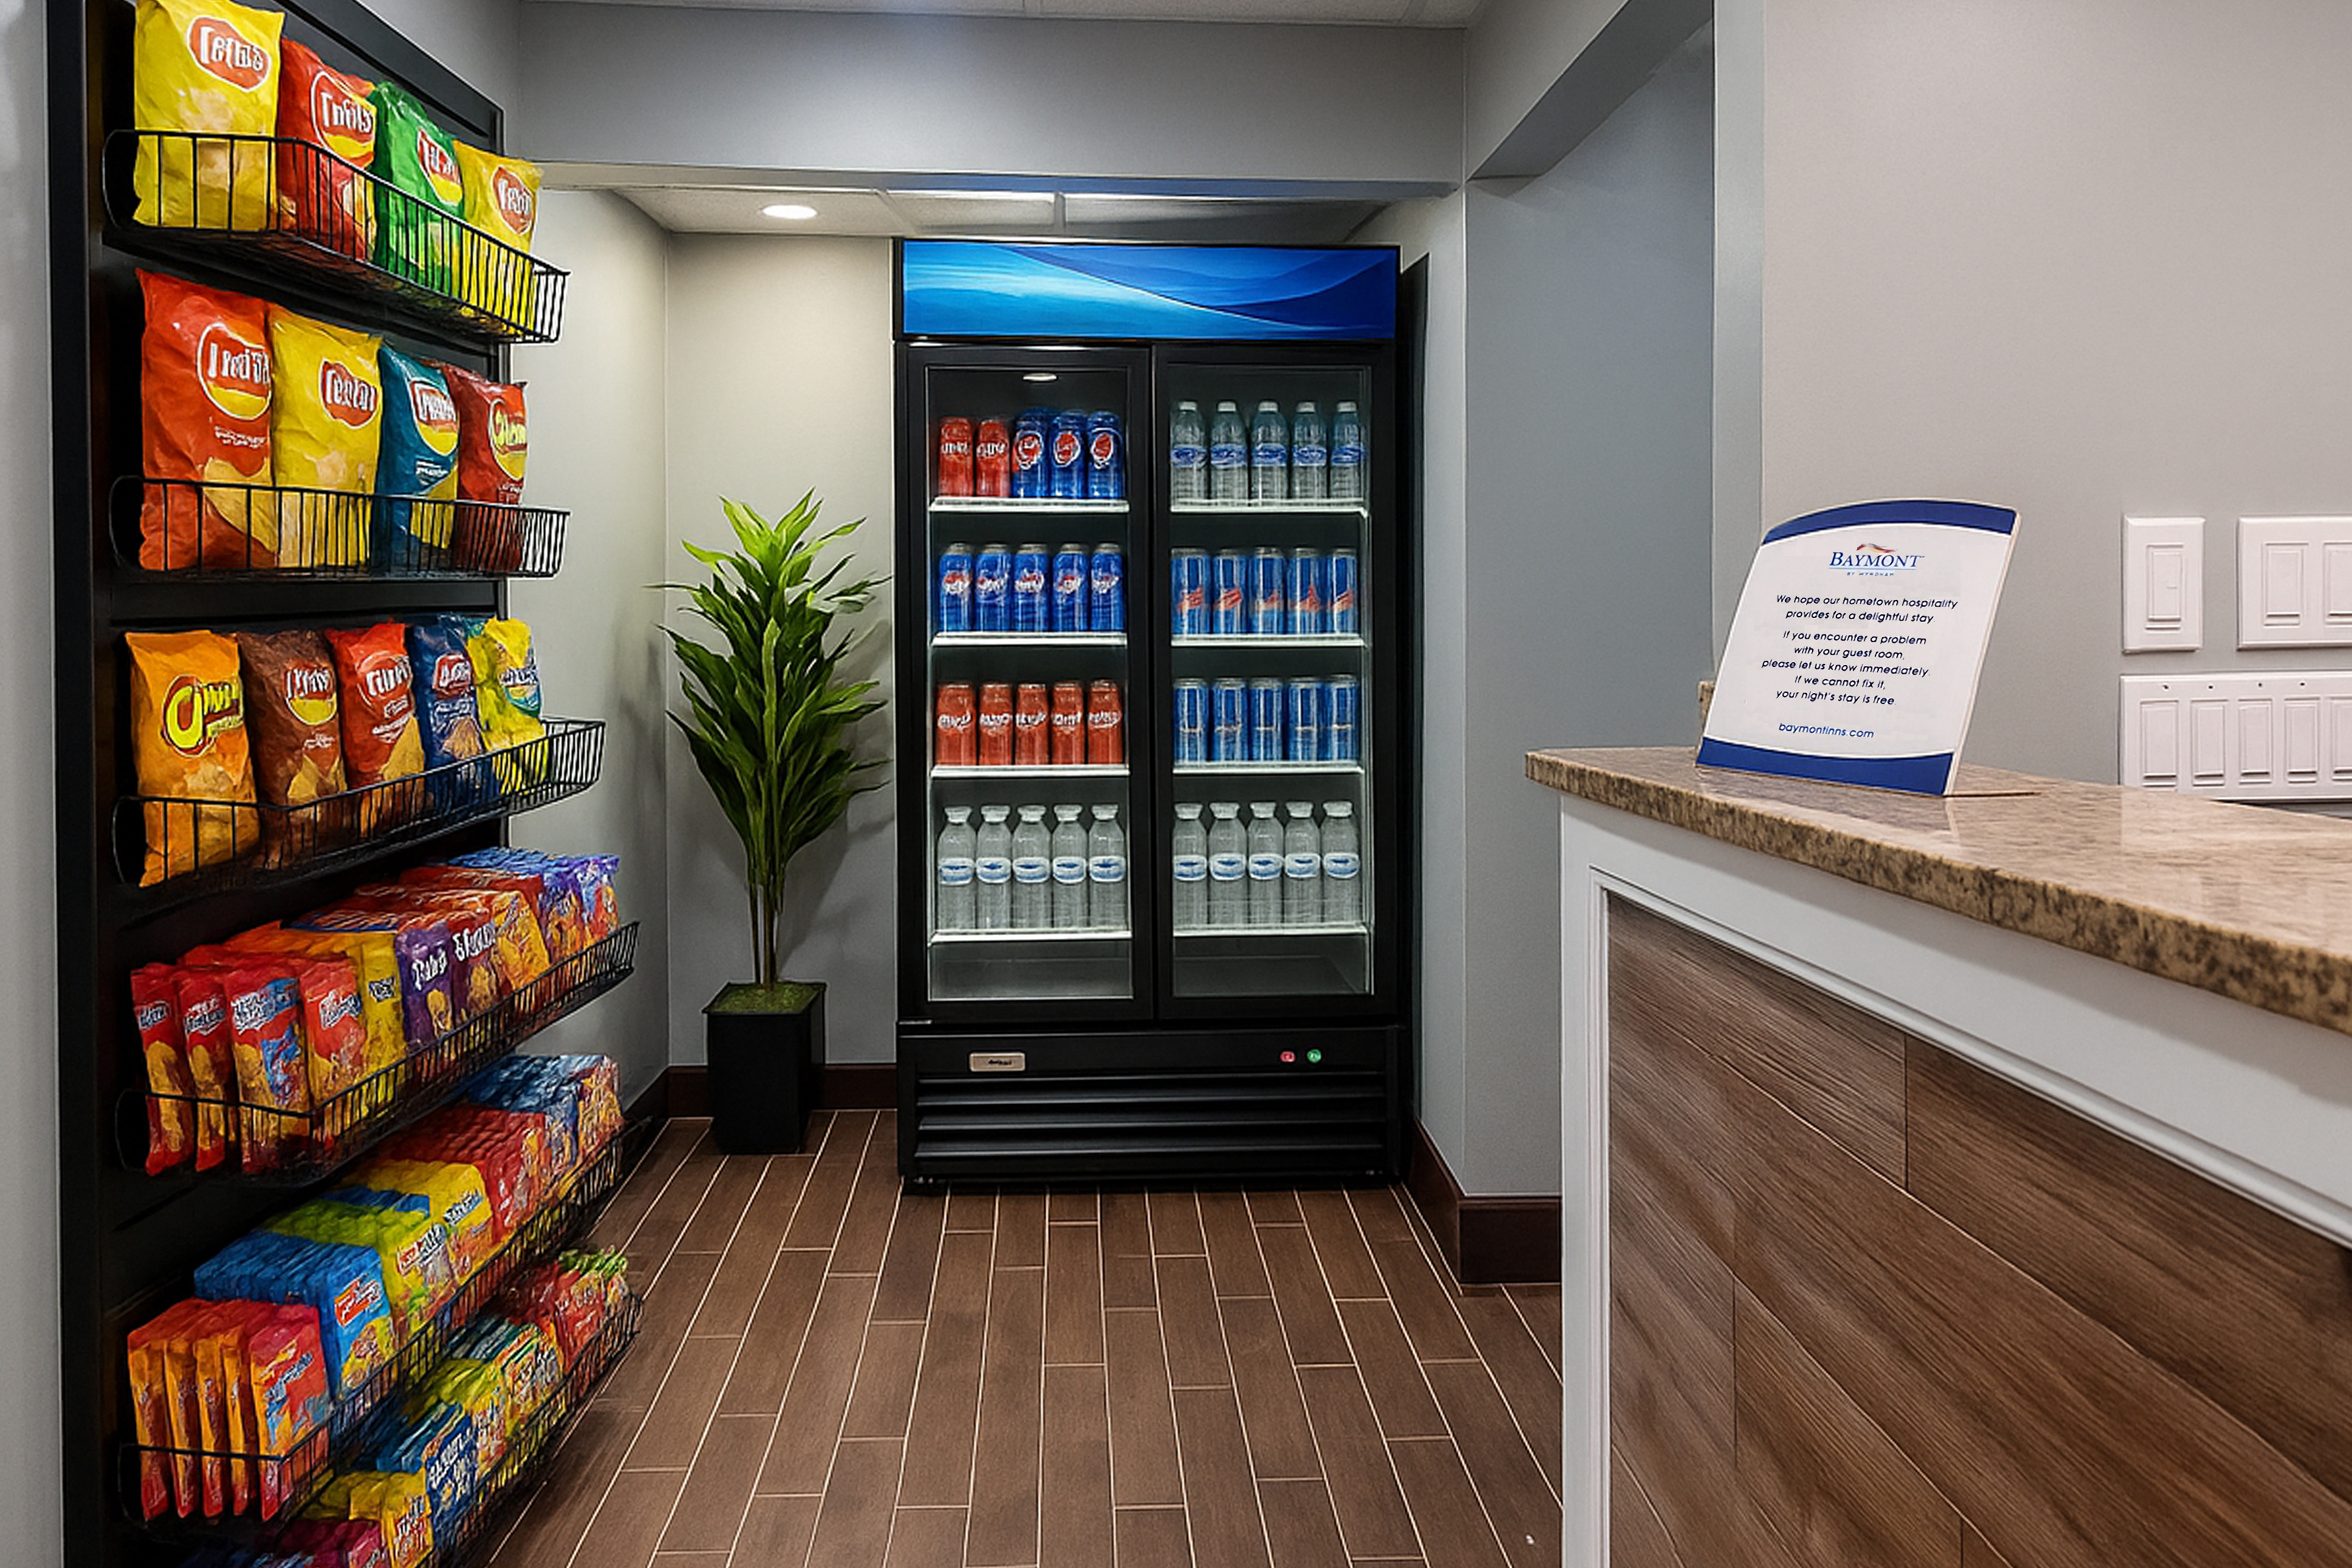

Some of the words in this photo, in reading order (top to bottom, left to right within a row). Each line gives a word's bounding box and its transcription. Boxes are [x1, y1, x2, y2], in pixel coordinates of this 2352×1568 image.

[1829, 552, 1920, 568] BAYMONT
[1776, 594, 1792, 604] We
[1793, 595, 1821, 605] hope
[1842, 596, 1899, 606] hometown
[1901, 598, 1958, 610] hospitality
[1785, 610, 1830, 619] provides
[1832, 610, 1847, 620] for
[1858, 611, 1909, 623] delightful
[1783, 630, 1790, 639] If
[1791, 632, 1811, 641] you
[1814, 633, 1868, 642] encounter
[1879, 635, 1927, 645] problem
[1794, 646, 1814, 655] with
[1816, 648, 1841, 657] your
[1842, 649, 1872, 659] guest
[1874, 651, 1905, 661] room,
[1761, 659, 1796, 669] please
[1798, 661, 1812, 670] let
[1828, 662, 1858, 672] know
[1795, 675, 1802, 683] If
[1804, 677, 1819, 686] we
[1821, 678, 1860, 687] cannot
[1862, 678, 1875, 689] fix
[1877, 680, 1885, 690] it,
[1776, 690, 1799, 699] your
[1800, 691, 1835, 702] night's
[1837, 693, 1860, 705] stay
[1862, 694, 1870, 704] is
[1779, 722, 1875, 738] baymontinns.com
